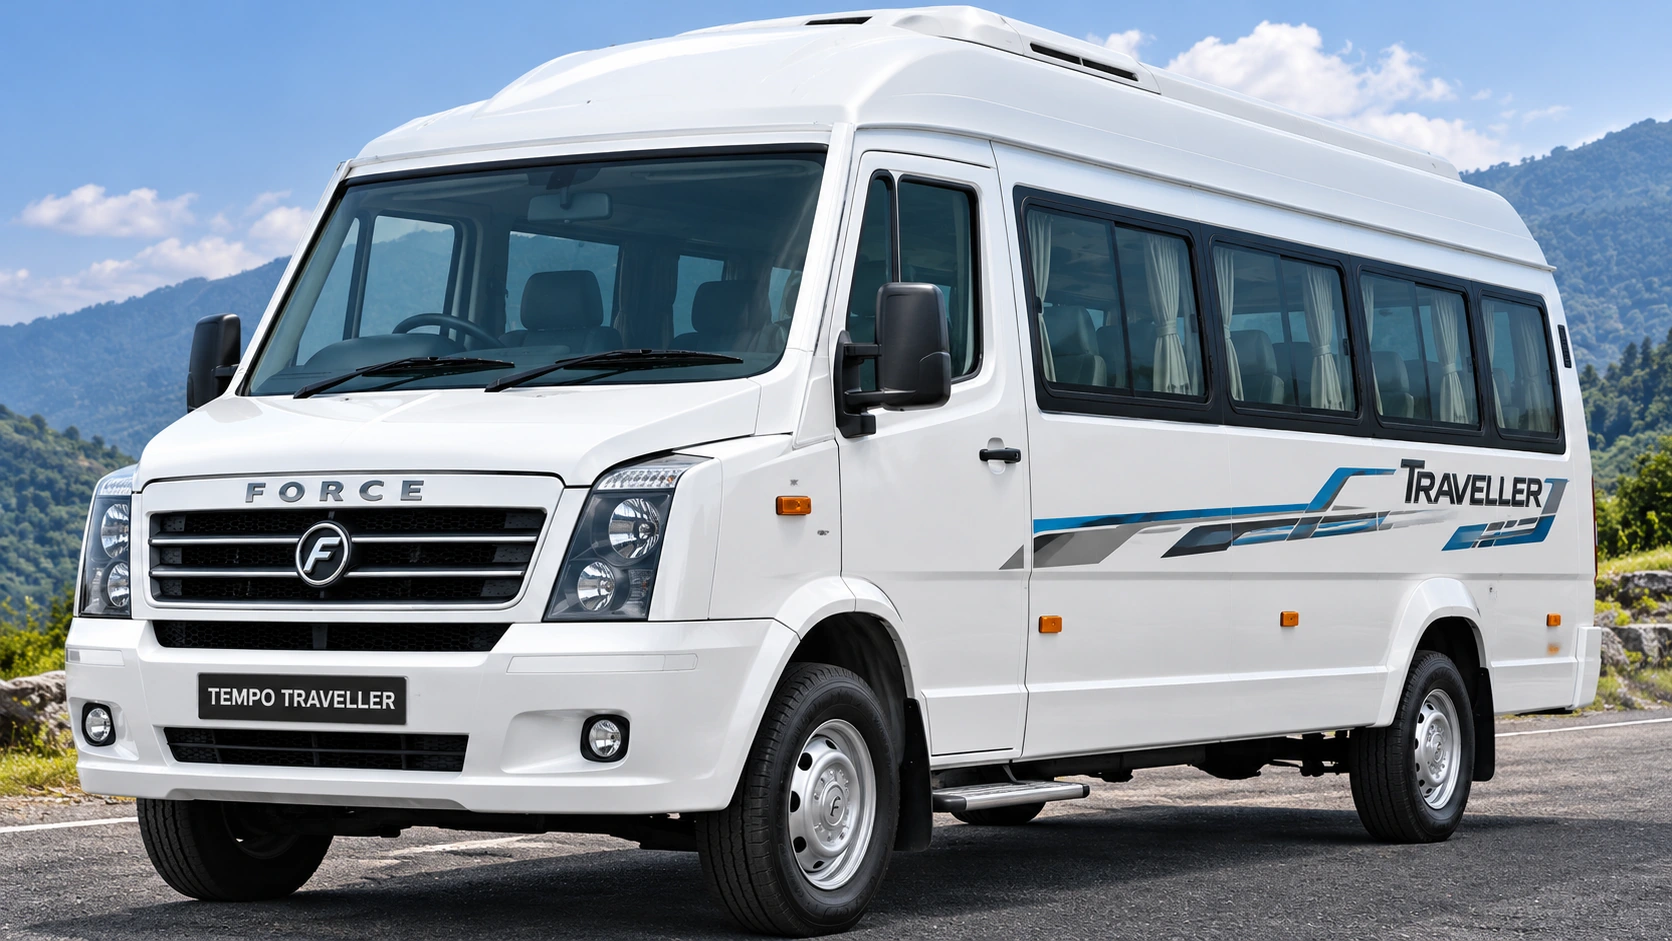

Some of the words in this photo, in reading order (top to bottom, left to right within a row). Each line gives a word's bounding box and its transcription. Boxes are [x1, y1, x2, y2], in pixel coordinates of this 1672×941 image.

[245, 480, 424, 503] FORCE
[1400, 458, 1543, 508] TRAVELLER
[207, 687, 275, 707] TEMPO
[281, 689, 396, 710] TRAVELLER
